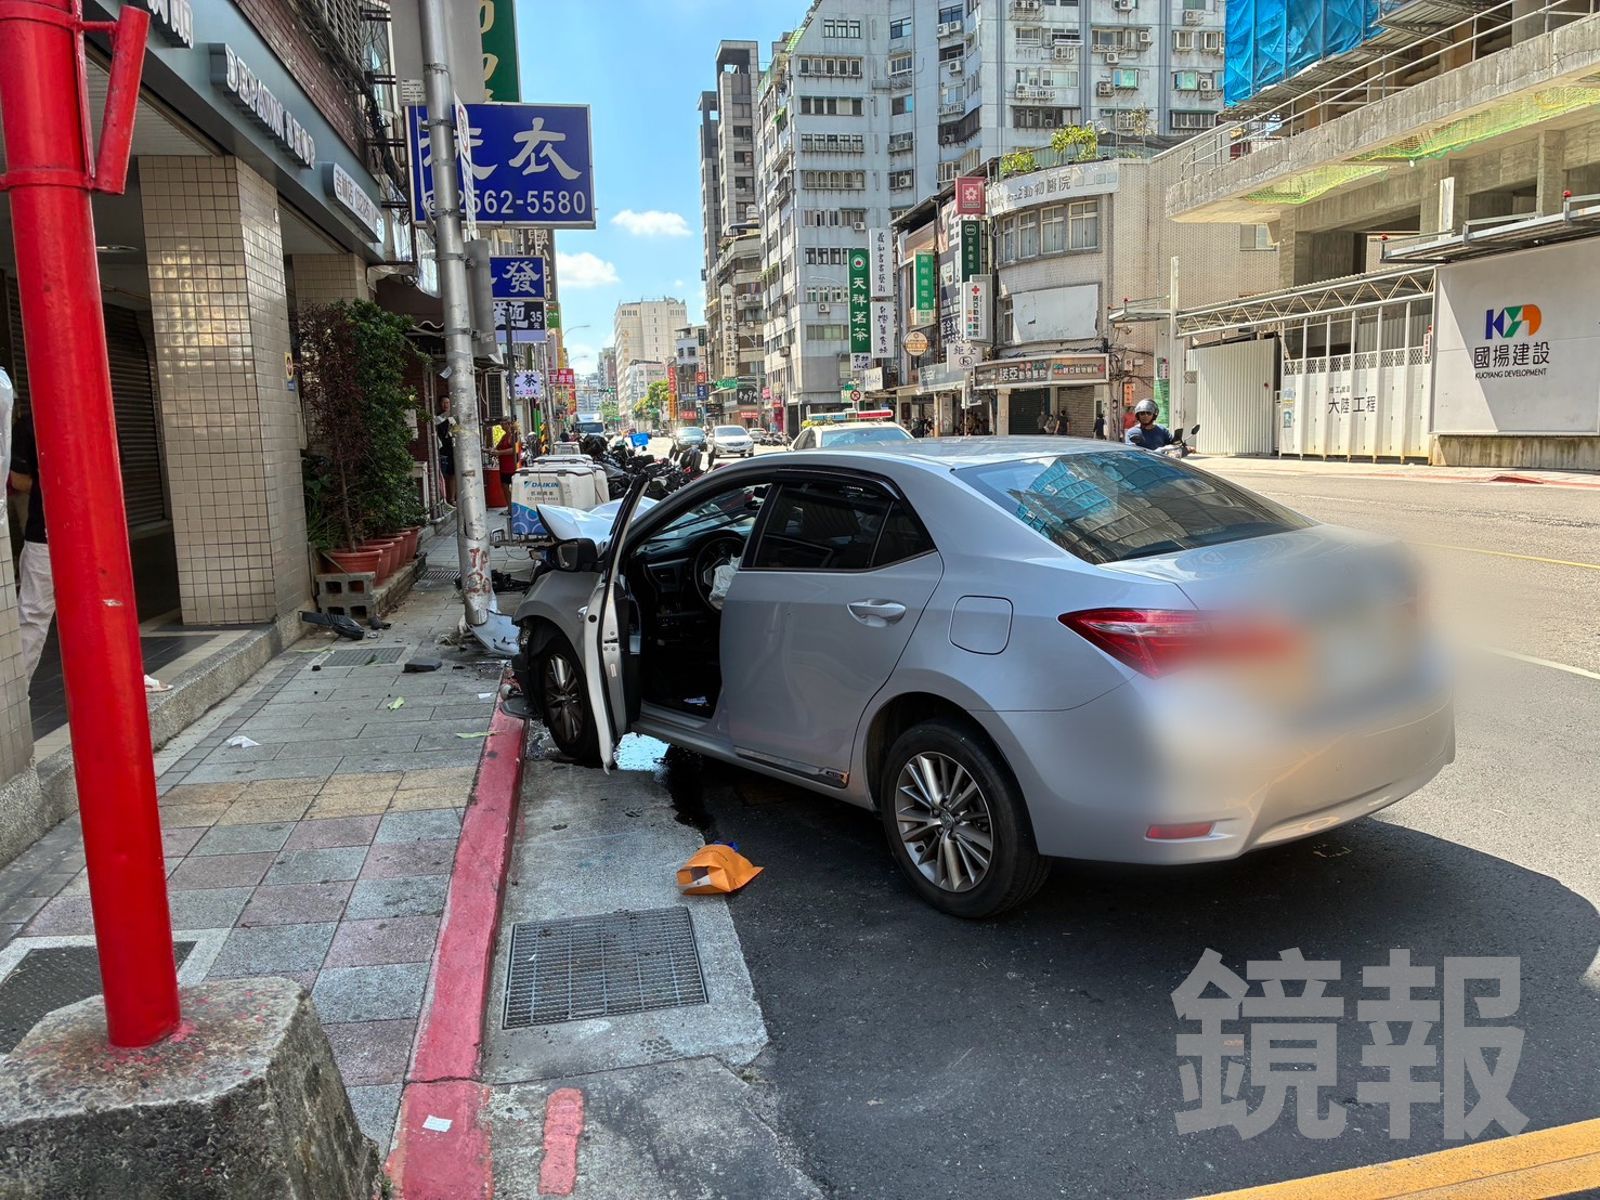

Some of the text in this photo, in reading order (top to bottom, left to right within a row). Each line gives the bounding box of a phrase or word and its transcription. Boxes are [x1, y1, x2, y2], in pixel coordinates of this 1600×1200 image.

[530, 311, 543, 322] 35
[1474, 341, 1551, 369] 國揚建設
[1475, 367, 1547, 380] KUOYANG DEVELOPMENT
[1328, 396, 1377, 415] 大陸工程
